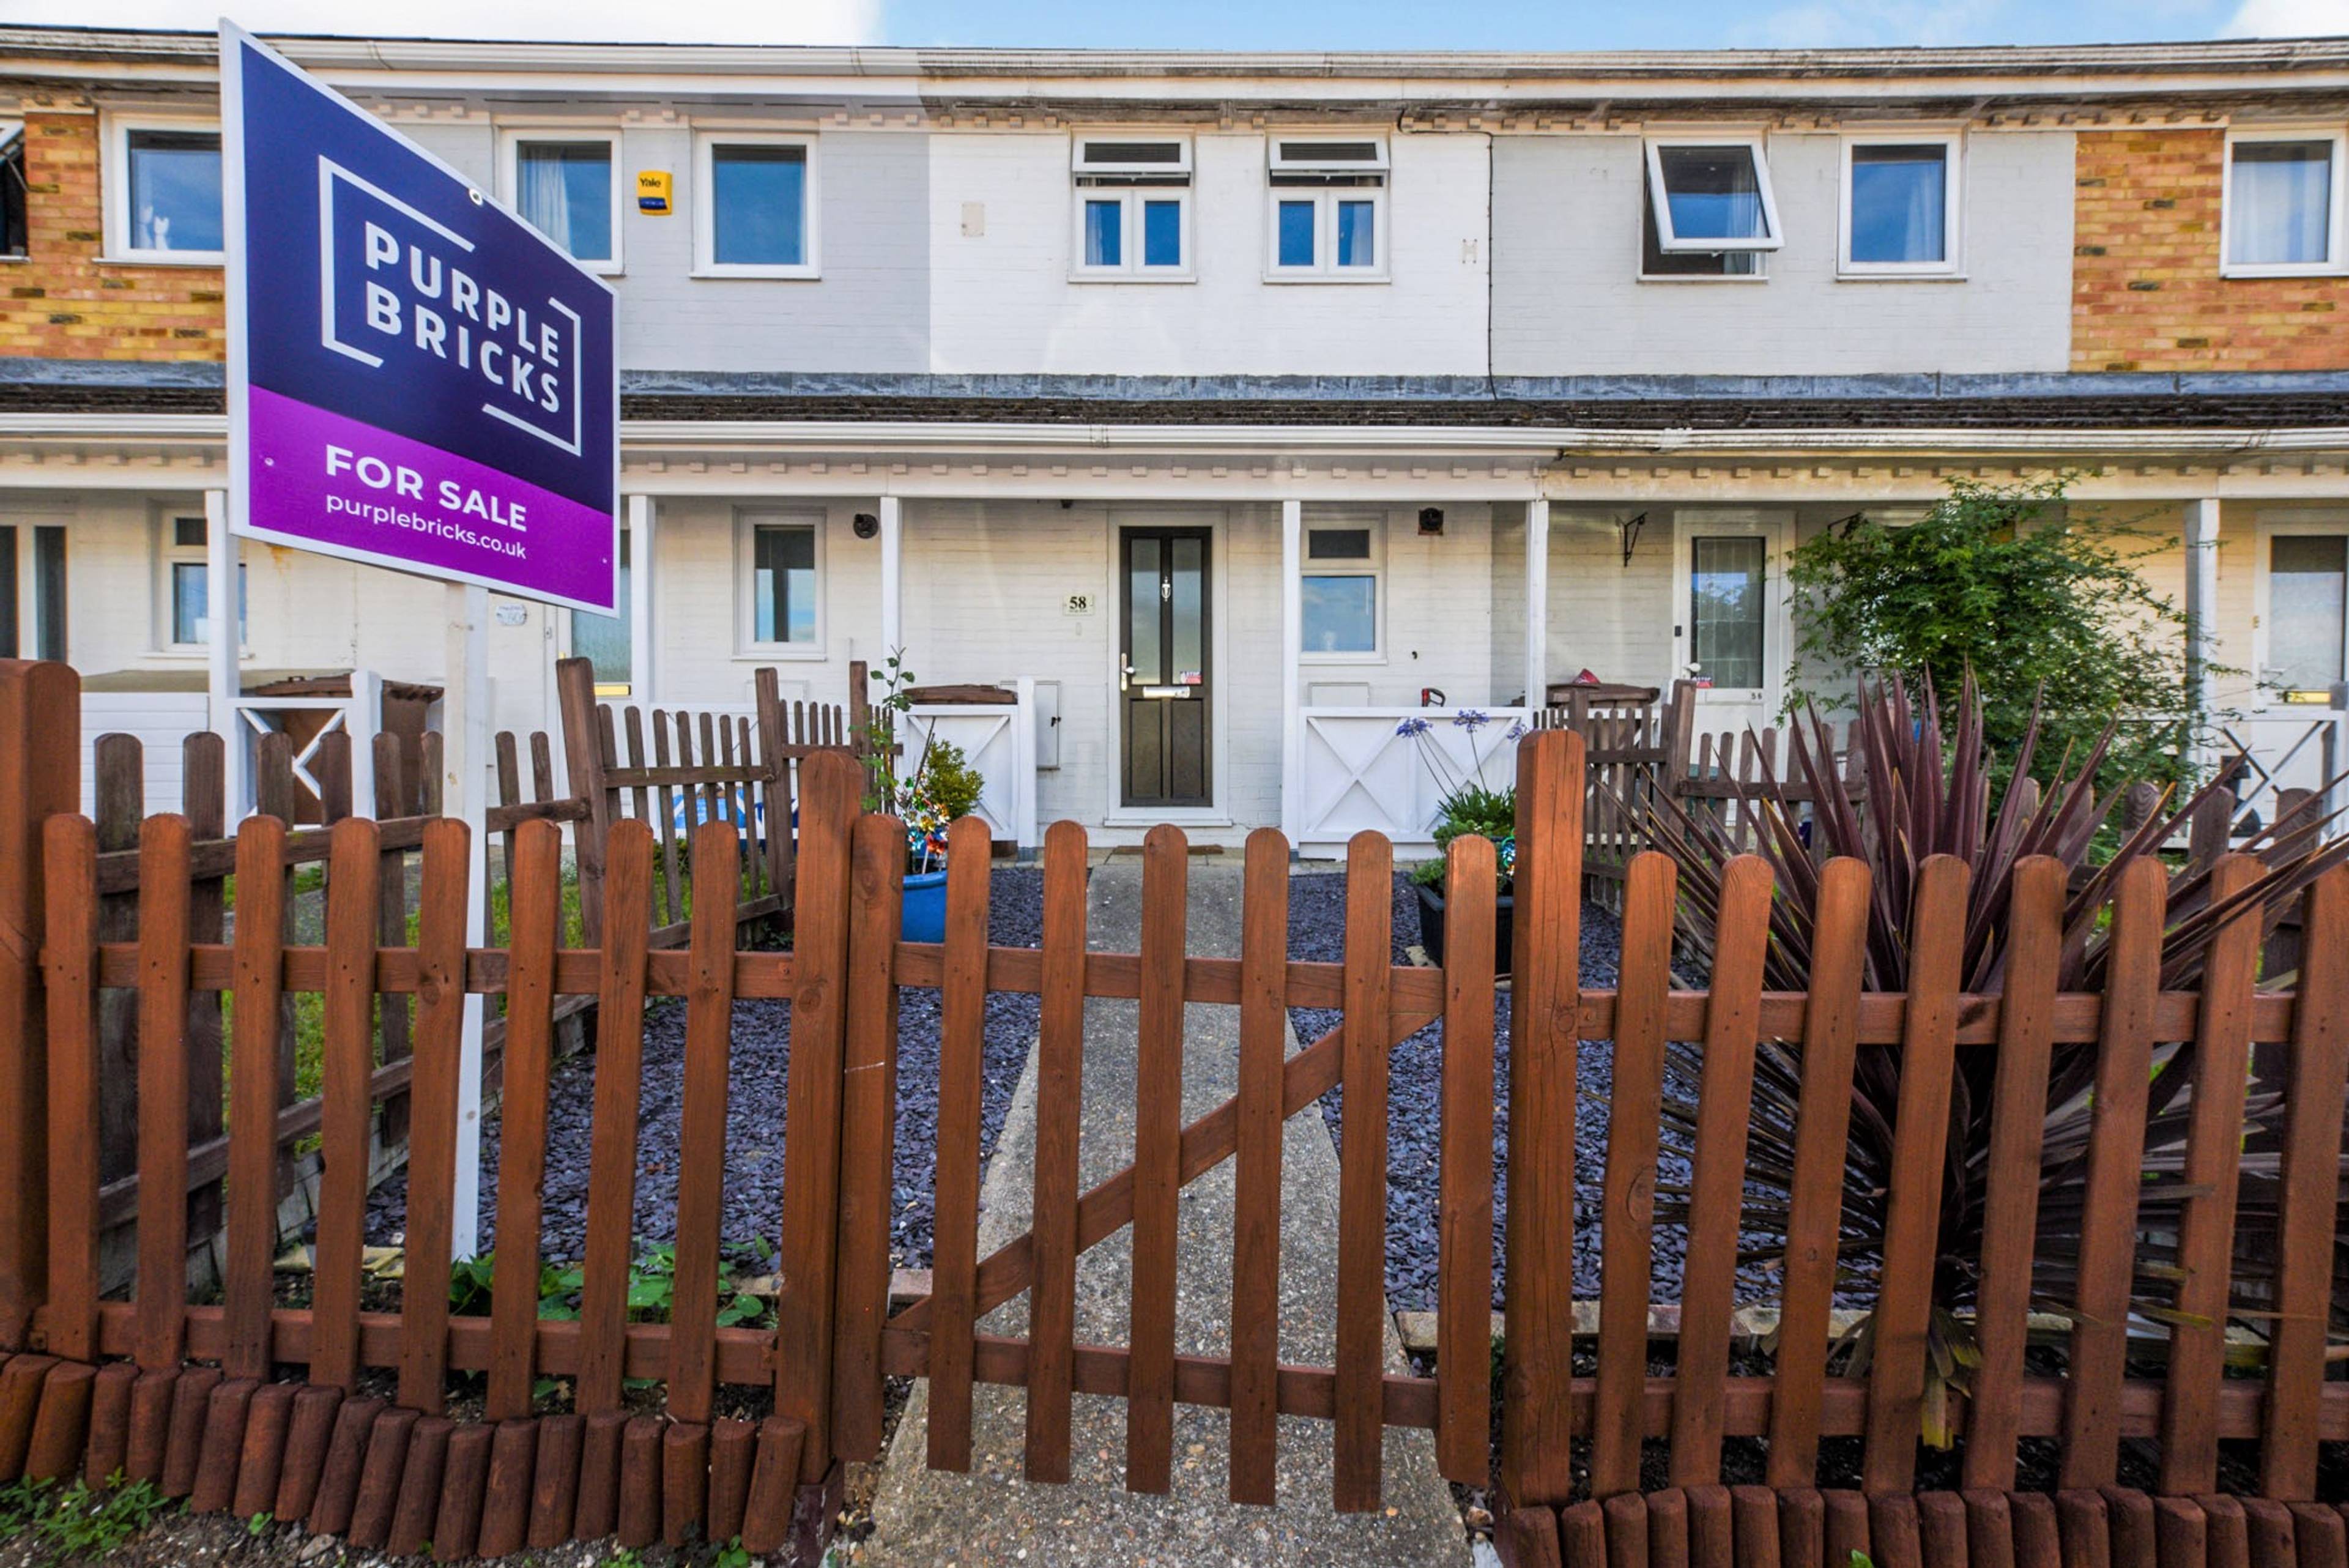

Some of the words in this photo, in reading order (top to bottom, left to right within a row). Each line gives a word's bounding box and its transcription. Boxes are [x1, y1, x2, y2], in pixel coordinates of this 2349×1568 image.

[640, 177, 661, 188] Yale
[365, 220, 559, 368] PURPLE
[366, 281, 559, 413] BRICKS
[326, 444, 423, 500] FOR
[439, 480, 527, 532] SALE
[326, 493, 527, 559] purplebricks.co.uk
[1069, 596, 1087, 609] 58
